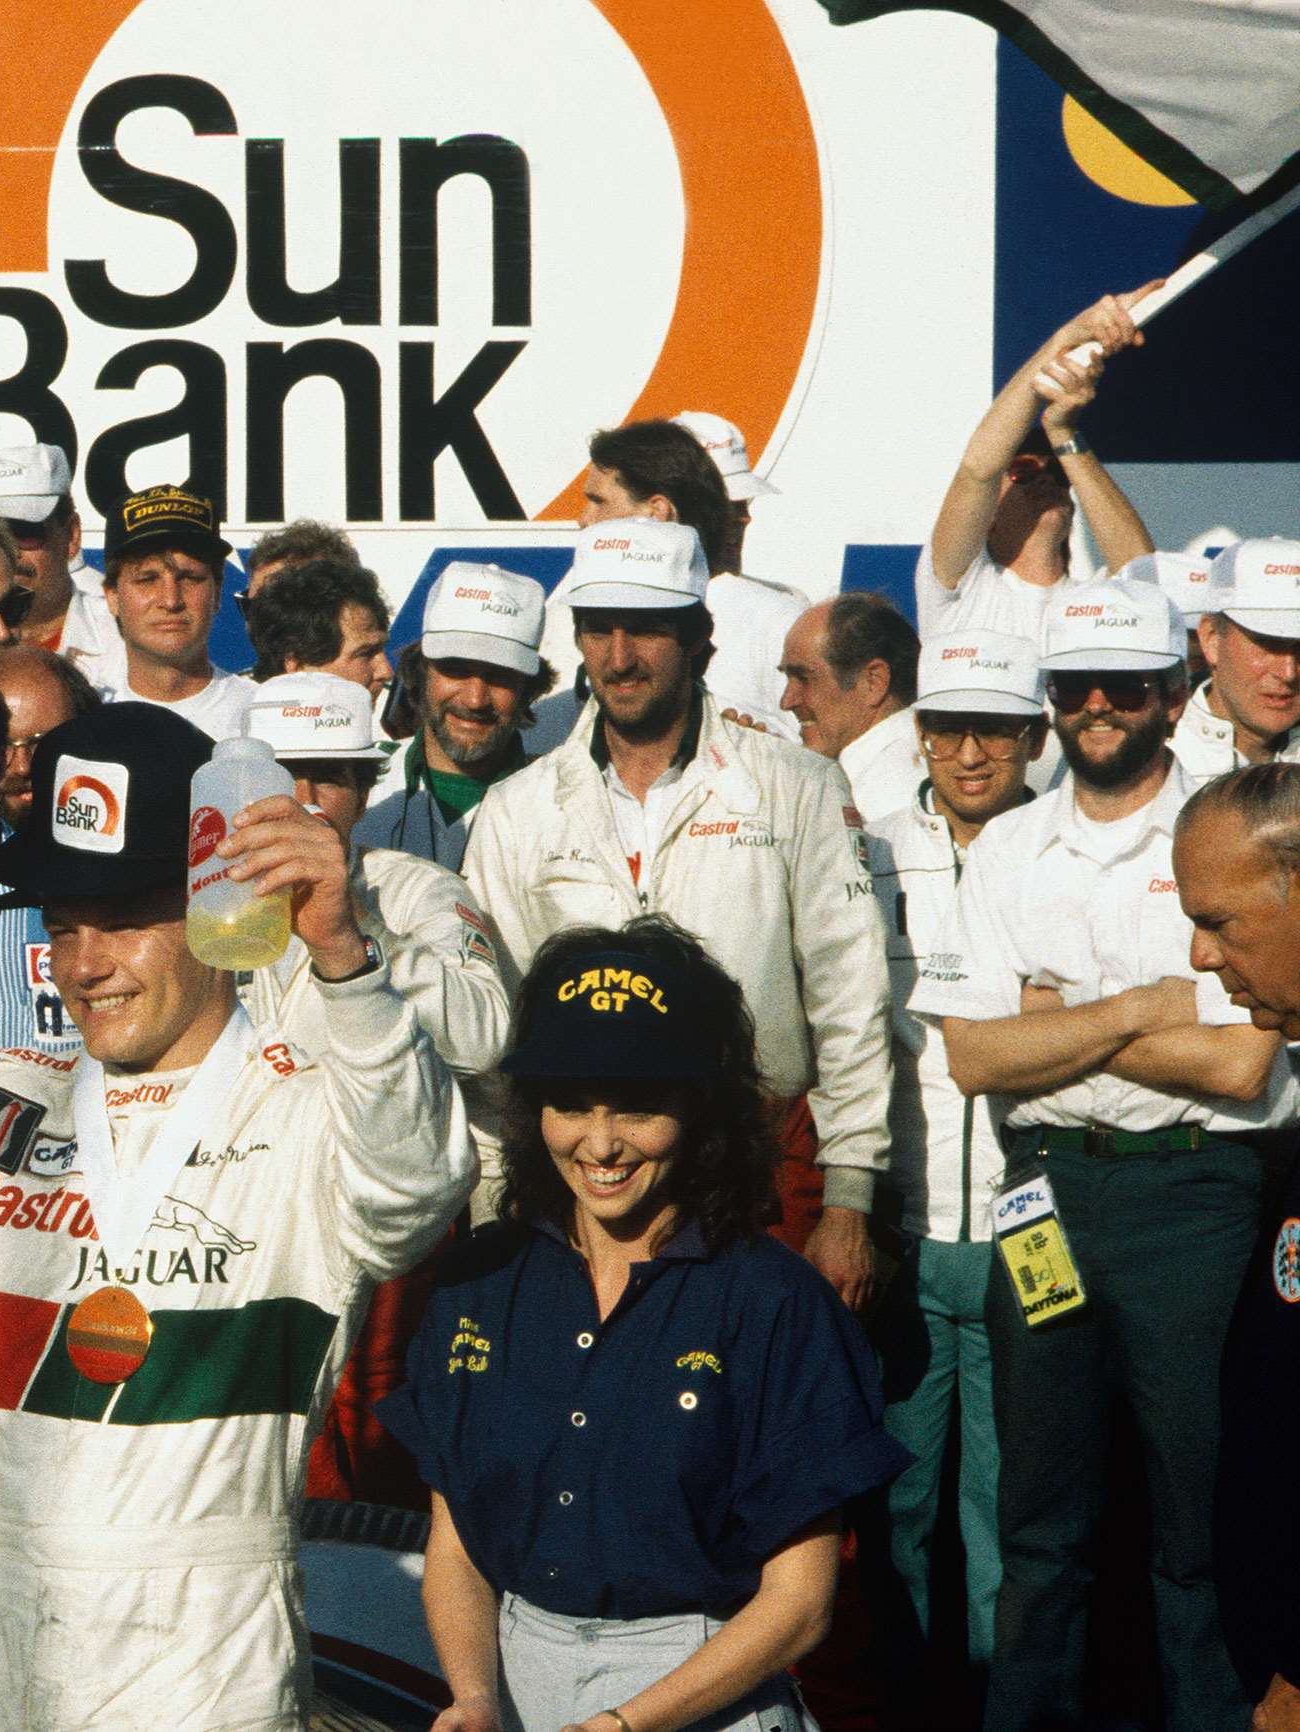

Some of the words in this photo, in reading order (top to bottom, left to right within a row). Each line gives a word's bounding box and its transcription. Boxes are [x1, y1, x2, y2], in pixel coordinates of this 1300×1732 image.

[63, 73, 532, 330] Sun
[134, 502, 204, 519] DUNLOP
[593, 539, 631, 551] Castrol
[622, 552, 662, 562] JAGUAR
[454, 586, 492, 601] Castrol
[481, 602, 519, 617] JAGUAR
[1065, 604, 1104, 617] Castrol
[1094, 618, 1138, 628] JAGUAR
[941, 647, 978, 660] Castrol
[969, 660, 1009, 671] JAGUAR
[282, 705, 323, 718] Castrol
[314, 718, 351, 730] JAGUAR
[67, 796, 99, 820] Sun
[56, 806, 98, 833] Bank
[688, 819, 740, 838] Castrol
[557, 967, 669, 1015] CAMEL
[589, 990, 631, 1013] GT
[105, 1083, 174, 1108] Castrol
[61, 1154, 76, 1170] GT
[998, 1190, 1045, 1218] CAMEL
[1022, 1287, 1079, 1317] DAYTONA
[451, 1332, 492, 1353] CAMEL
[675, 1350, 722, 1374] CAMEL
